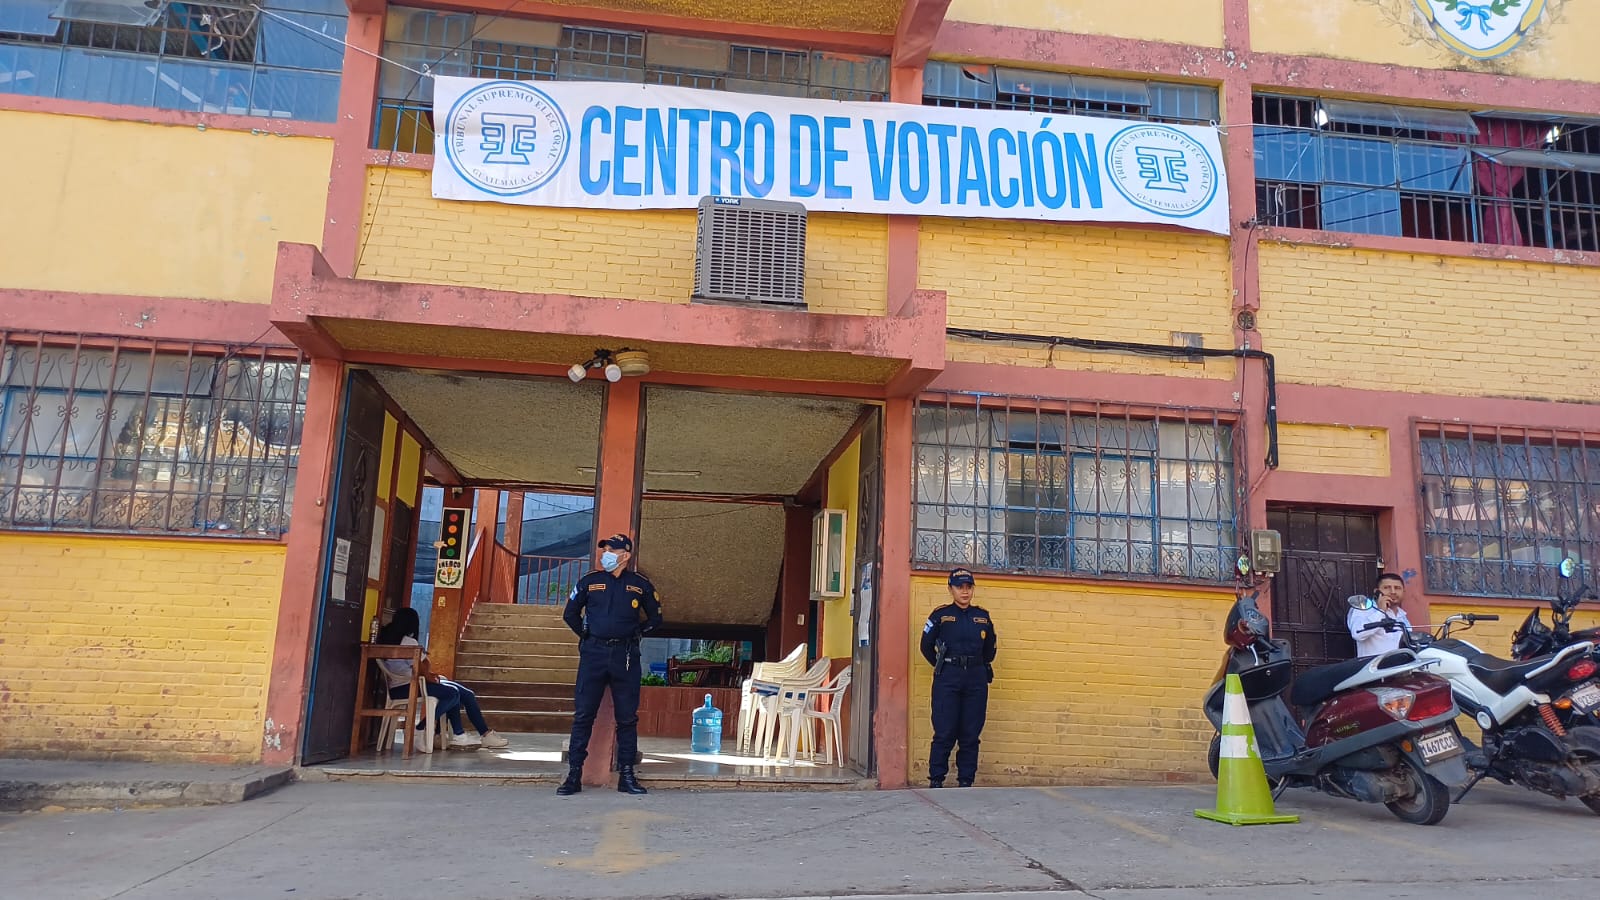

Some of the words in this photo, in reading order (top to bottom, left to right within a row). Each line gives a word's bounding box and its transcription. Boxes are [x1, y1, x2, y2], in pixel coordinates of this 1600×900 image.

[455, 102, 478, 154] TRIBUNAL
[476, 89, 534, 105] SUPREMO
[534, 101, 562, 160] ELECTORAL
[579, 105, 775, 199] CENTRO
[789, 114, 853, 200] DE
[863, 116, 1104, 210] VOTACIÓN
[472, 167, 526, 187] GUATEMALA
[1114, 139, 1132, 182] TRIBUNAL
[1130, 130, 1179, 142] SUPREMO
[1179, 139, 1210, 191] ELECTORAL
